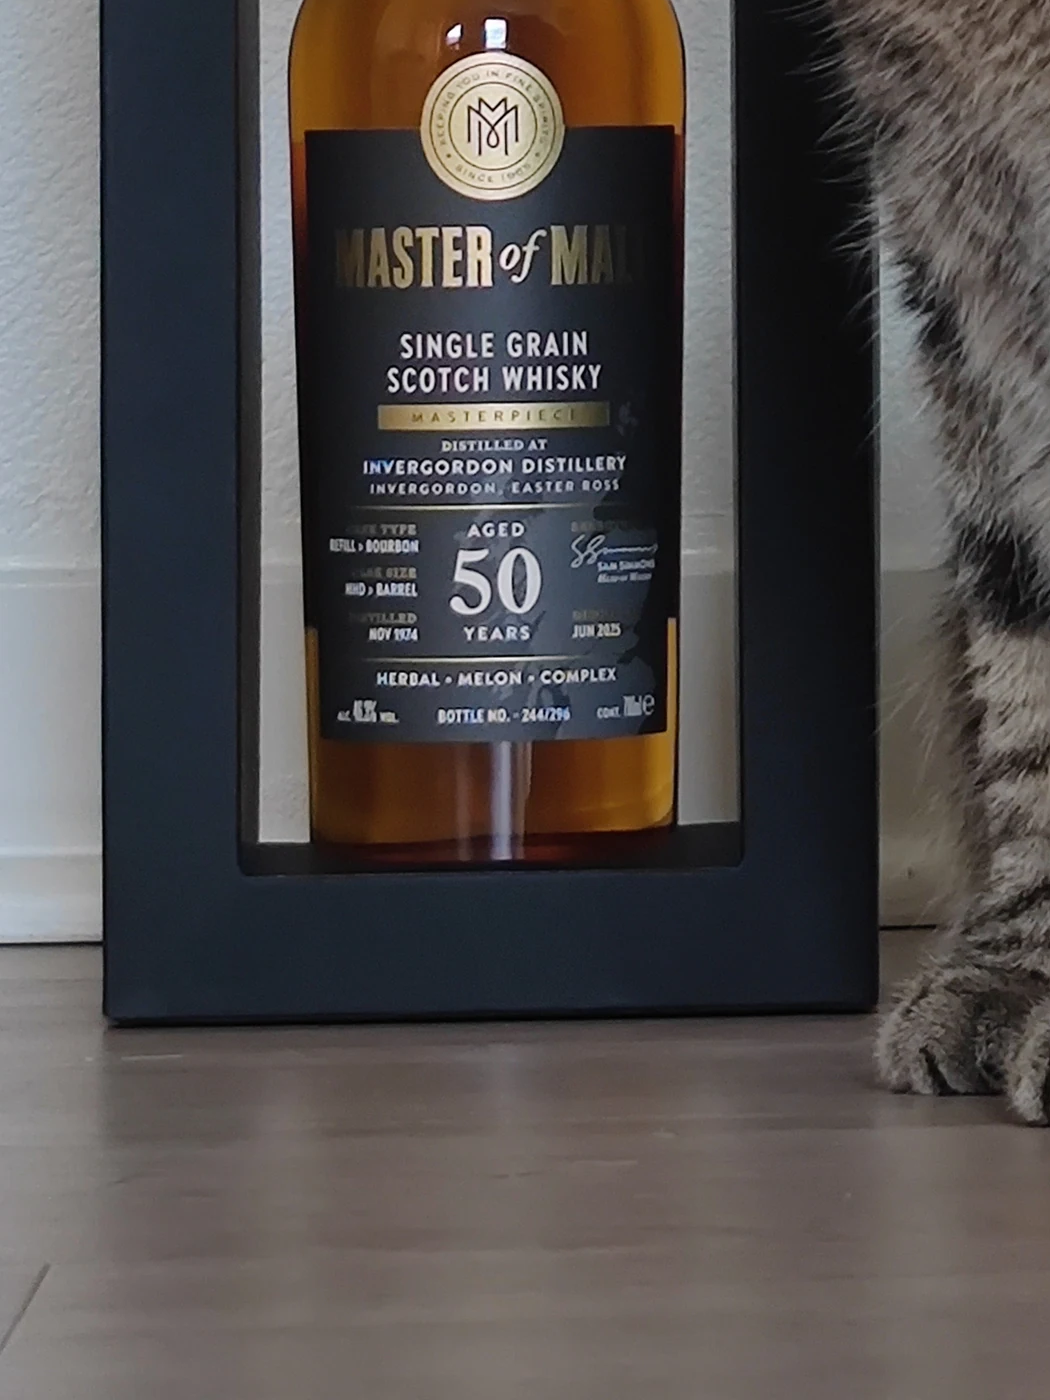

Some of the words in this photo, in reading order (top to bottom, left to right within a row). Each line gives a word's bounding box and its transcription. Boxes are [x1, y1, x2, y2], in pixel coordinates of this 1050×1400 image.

[336, 225, 493, 288] MASTER
[500, 229, 547, 284] of
[550, 225, 635, 286] MAL
[400, 331, 494, 360] SINGLE
[506, 330, 588, 357] GRAIN
[387, 366, 489, 393] SCOTCH
[502, 364, 602, 390] WHISKY
[441, 439, 524, 453] DISTILLED
[527, 438, 548, 451] AT
[363, 457, 513, 476] INVERGORDON
[522, 455, 627, 474] DISTILLERY
[512, 480, 573, 494] EASTER
[581, 478, 620, 492] ROSS
[467, 521, 526, 538] AGED
[366, 539, 419, 553] BOURBON
[449, 546, 543, 615] 50
[376, 582, 418, 597] BARREL
[368, 627, 392, 641] NOV
[463, 625, 532, 642] YEARS
[571, 624, 595, 639] JUN
[376, 671, 442, 687] HERBAL
[457, 671, 522, 687] MELON
[539, 667, 617, 685] COMPLEX
[437, 708, 485, 724] BOTTLE
